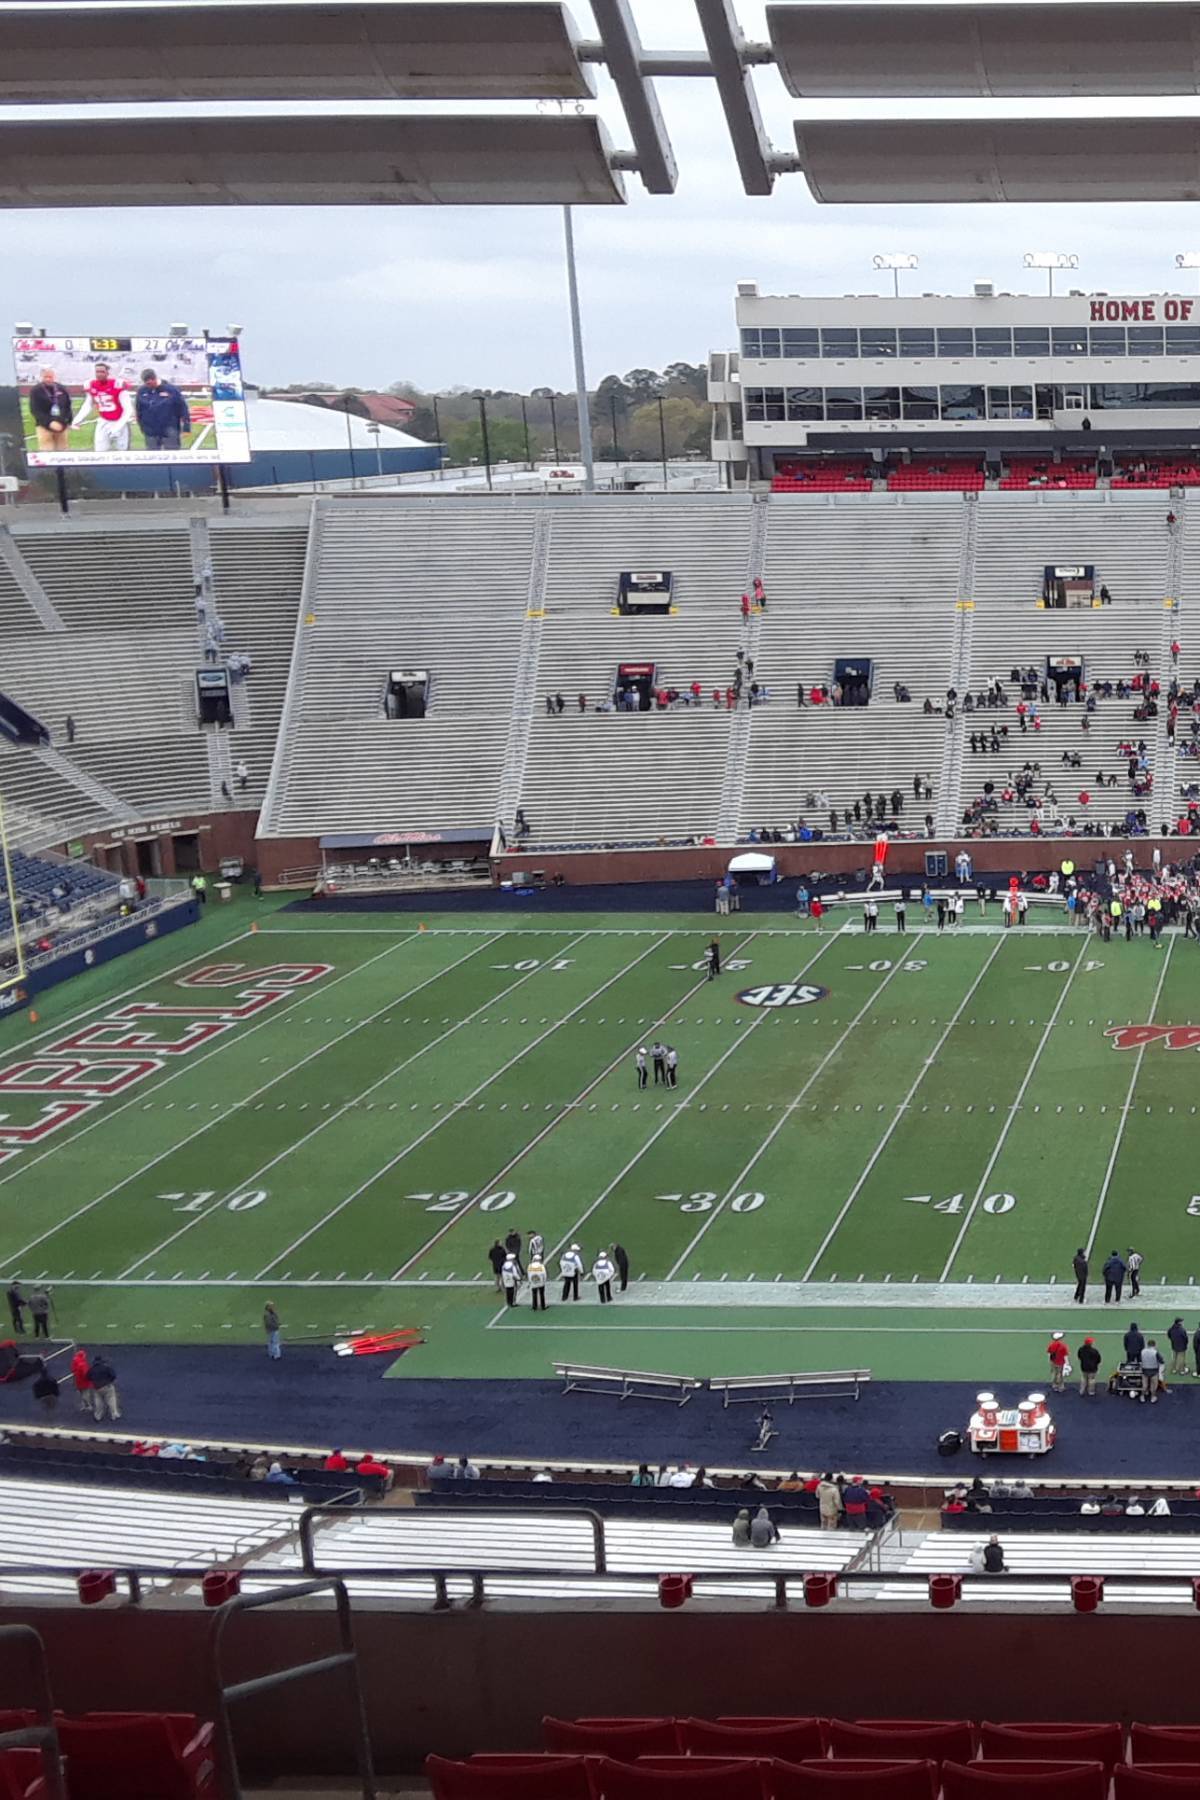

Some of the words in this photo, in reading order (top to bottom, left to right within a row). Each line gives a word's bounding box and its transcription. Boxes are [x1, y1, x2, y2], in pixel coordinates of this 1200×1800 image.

[1090, 300, 1155, 321] HOME
[1164, 300, 1193, 320] OF
[145, 339, 159, 350] 27
[514, 959, 576, 971] 10
[868, 958, 929, 972] 30
[1047, 960, 1105, 973] 40
[742, 984, 821, 1007] SEC
[172, 1190, 268, 1212] 10
[424, 1190, 516, 1212] 20
[679, 1191, 766, 1213] 30
[933, 1192, 1016, 1215] 40
